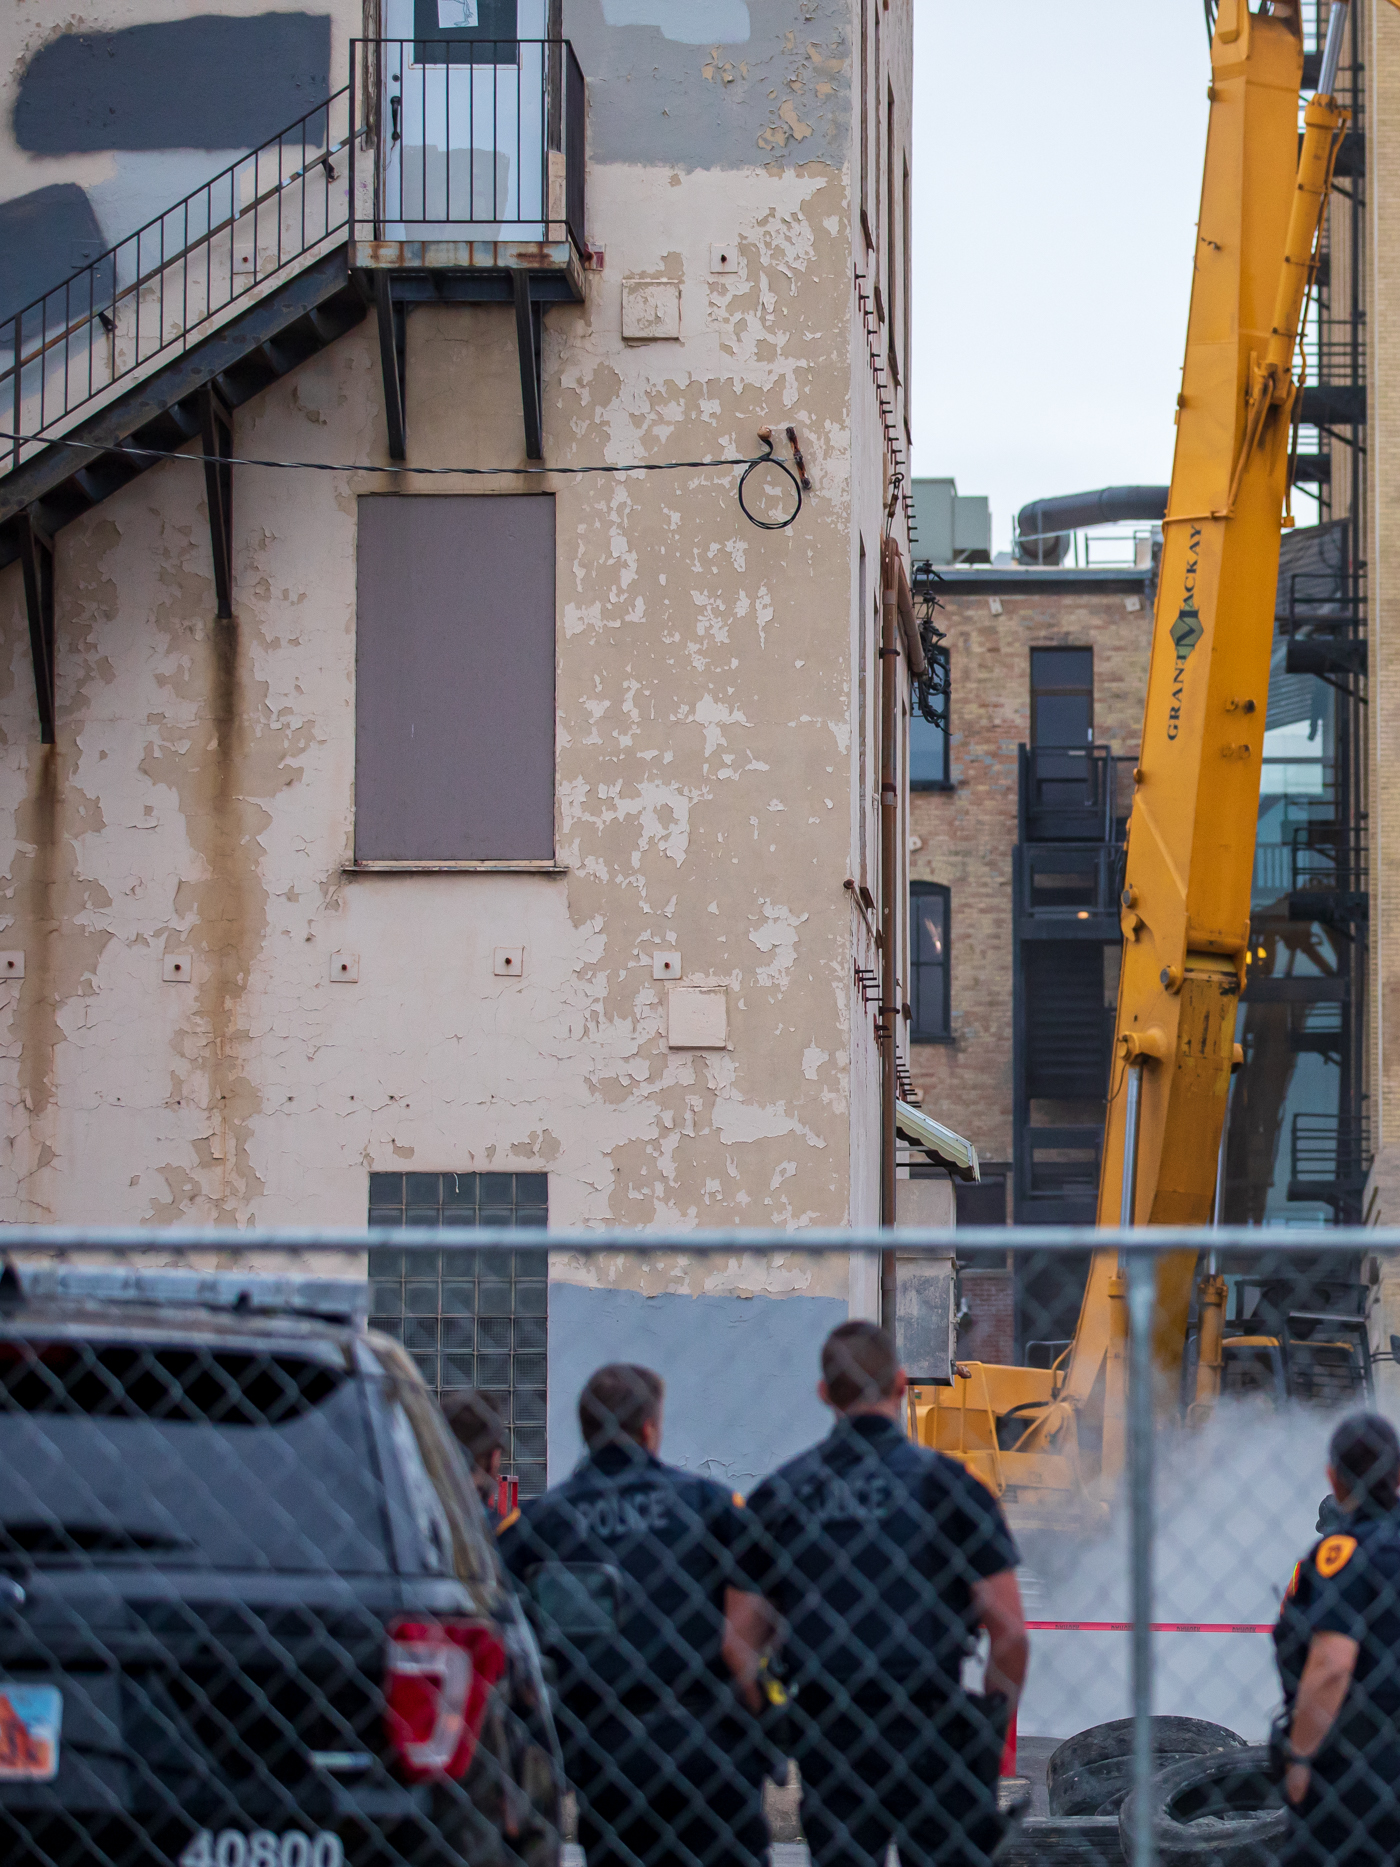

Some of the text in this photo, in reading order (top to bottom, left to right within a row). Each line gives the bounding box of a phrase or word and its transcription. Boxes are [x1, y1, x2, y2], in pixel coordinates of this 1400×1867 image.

[1167, 524, 1202, 741] GRANT MACKAY
[181, 1828, 345, 1867] 40800
